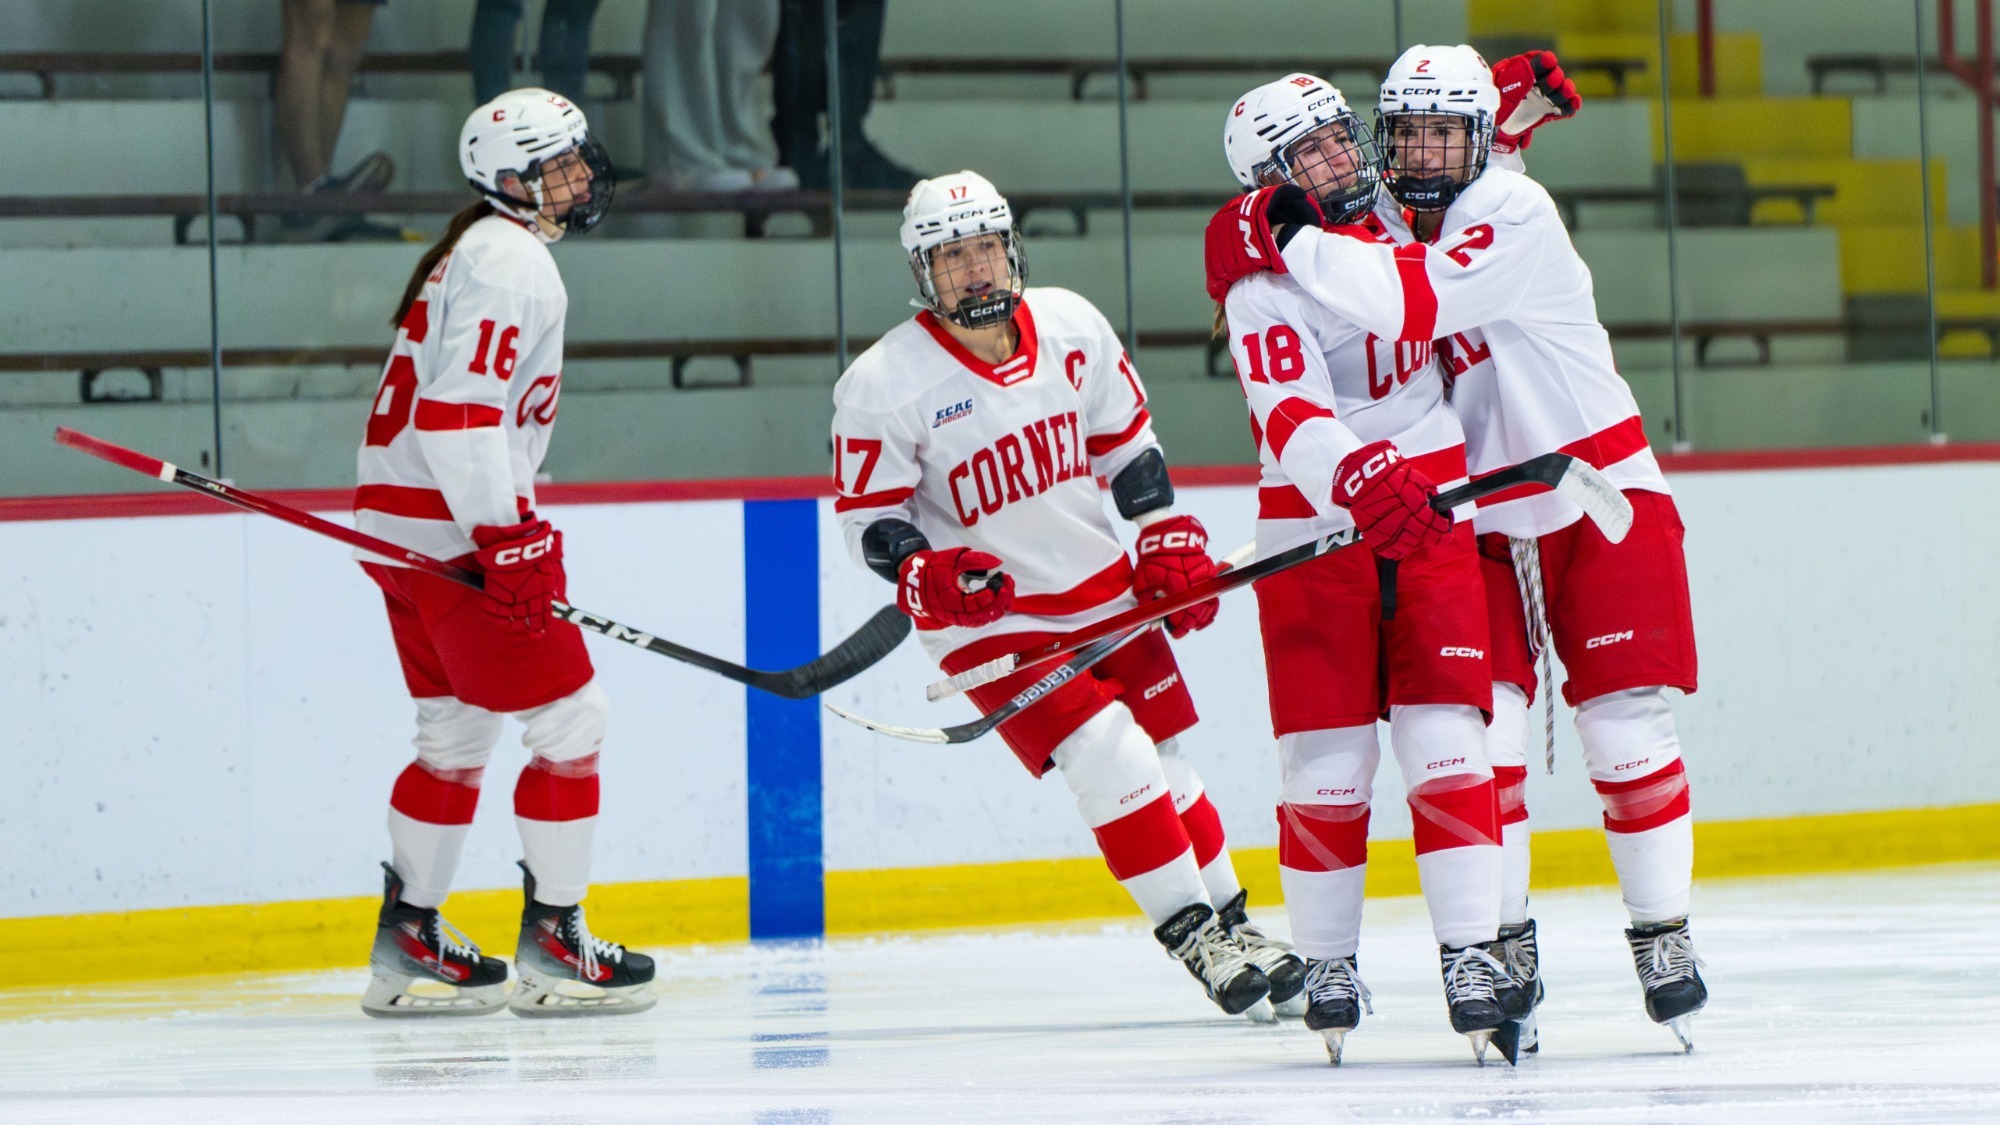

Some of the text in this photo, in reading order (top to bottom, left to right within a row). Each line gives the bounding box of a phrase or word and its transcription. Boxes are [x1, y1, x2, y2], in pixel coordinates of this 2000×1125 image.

[1416, 60, 1431, 73] 2
[1290, 76, 1315, 88] 18
[1502, 81, 1522, 93] CCM
[1402, 88, 1441, 96] CCM
[1234, 101, 1246, 117] C
[1307, 95, 1336, 112] CCM
[493, 110, 506, 122] C
[949, 186, 967, 200] 17
[1405, 191, 1440, 200] CCM
[948, 209, 984, 222] CCM
[1444, 223, 1494, 269] 2
[970, 302, 1005, 318] CCM
[468, 318, 519, 382] 16
[1242, 324, 1306, 385] 18
[1065, 349, 1086, 392] C
[936, 398, 973, 420] ECAC
[1140, 531, 1206, 555] CCM
[1586, 630, 1634, 649] CCM
[1440, 646, 1484, 660] CCM
[1011, 664, 1076, 709] BAUER
[1144, 672, 1178, 700] CCM
[1427, 757, 1466, 770] CCM
[1614, 757, 1650, 771] CCM
[1120, 784, 1151, 805] CCM
[1316, 788, 1356, 796] CCM
